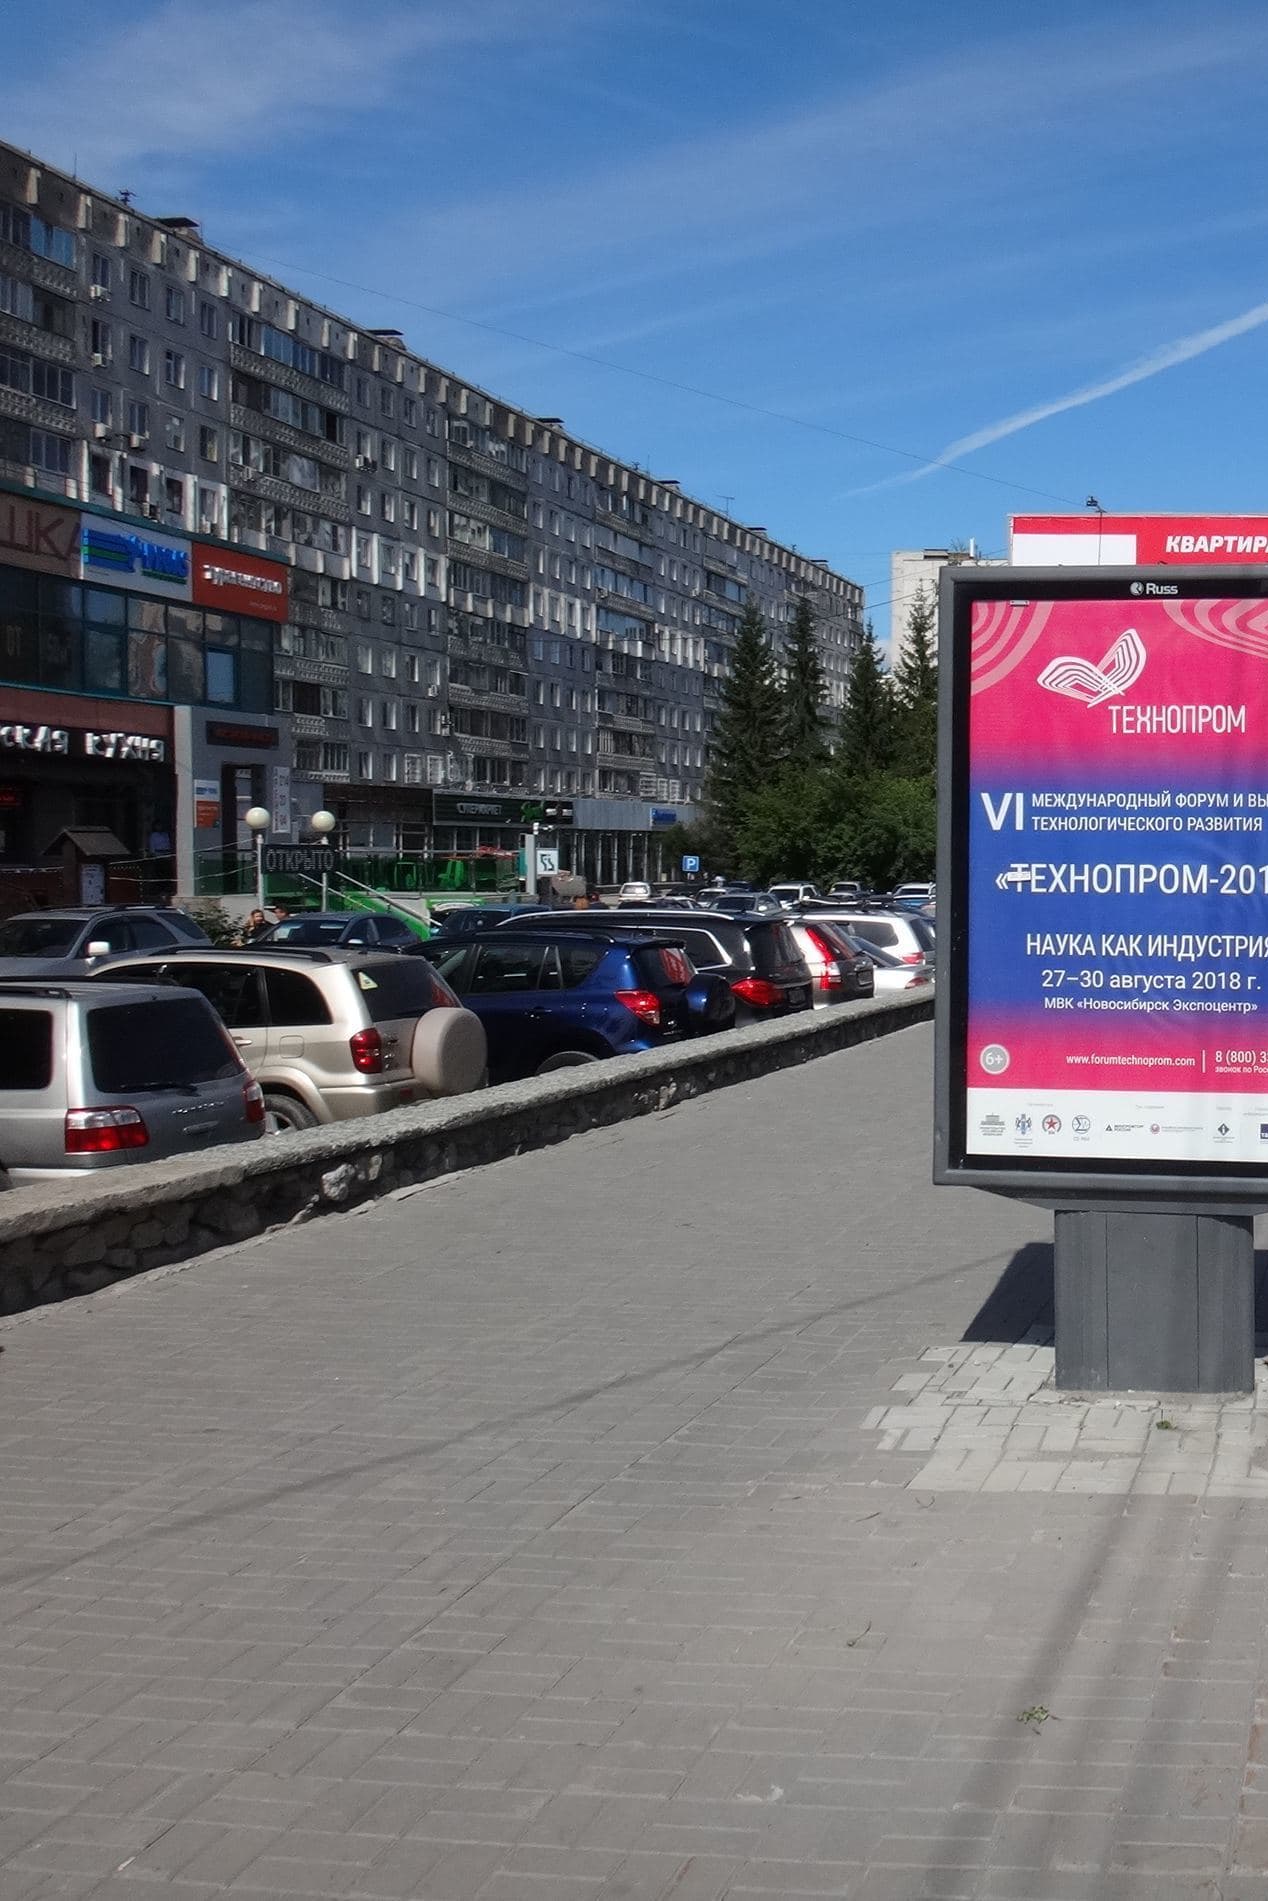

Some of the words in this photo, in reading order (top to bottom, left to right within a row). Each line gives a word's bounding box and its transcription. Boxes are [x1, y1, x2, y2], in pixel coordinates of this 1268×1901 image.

[1146, 582, 1179, 595] Russ
[1108, 705, 1246, 734] ТЕХНОПРОМ
[1032, 791, 1172, 809] МЕЖДУНАРОДНЫЙ
[1175, 793, 1229, 809] ФОРУМ
[1233, 794, 1244, 808] И
[980, 792, 1024, 831] VI
[1031, 816, 1183, 831] ТЕХНОЛОГИЧЕСКОГО
[1187, 817, 1263, 831] РАЗВИТИЯ
[686, 858, 696, 870] P
[1026, 934, 1096, 956] НАУКА
[1101, 935, 1143, 957] КАК
[1110, 974, 1187, 993] августа
[1192, 971, 1241, 990] 2018
[1246, 975, 1262, 990] г.
[1044, 997, 1074, 1010] МВК
[1077, 998, 1169, 1012] «Новосибирск
[1173, 999, 1258, 1014] Экспоцентр»
[985, 1052, 1003, 1066] 6+
[1066, 1053, 1196, 1068] www.forumtechnoprom.com
[1215, 1050, 1223, 1063] 8
[1226, 1049, 1256, 1065] (800)
